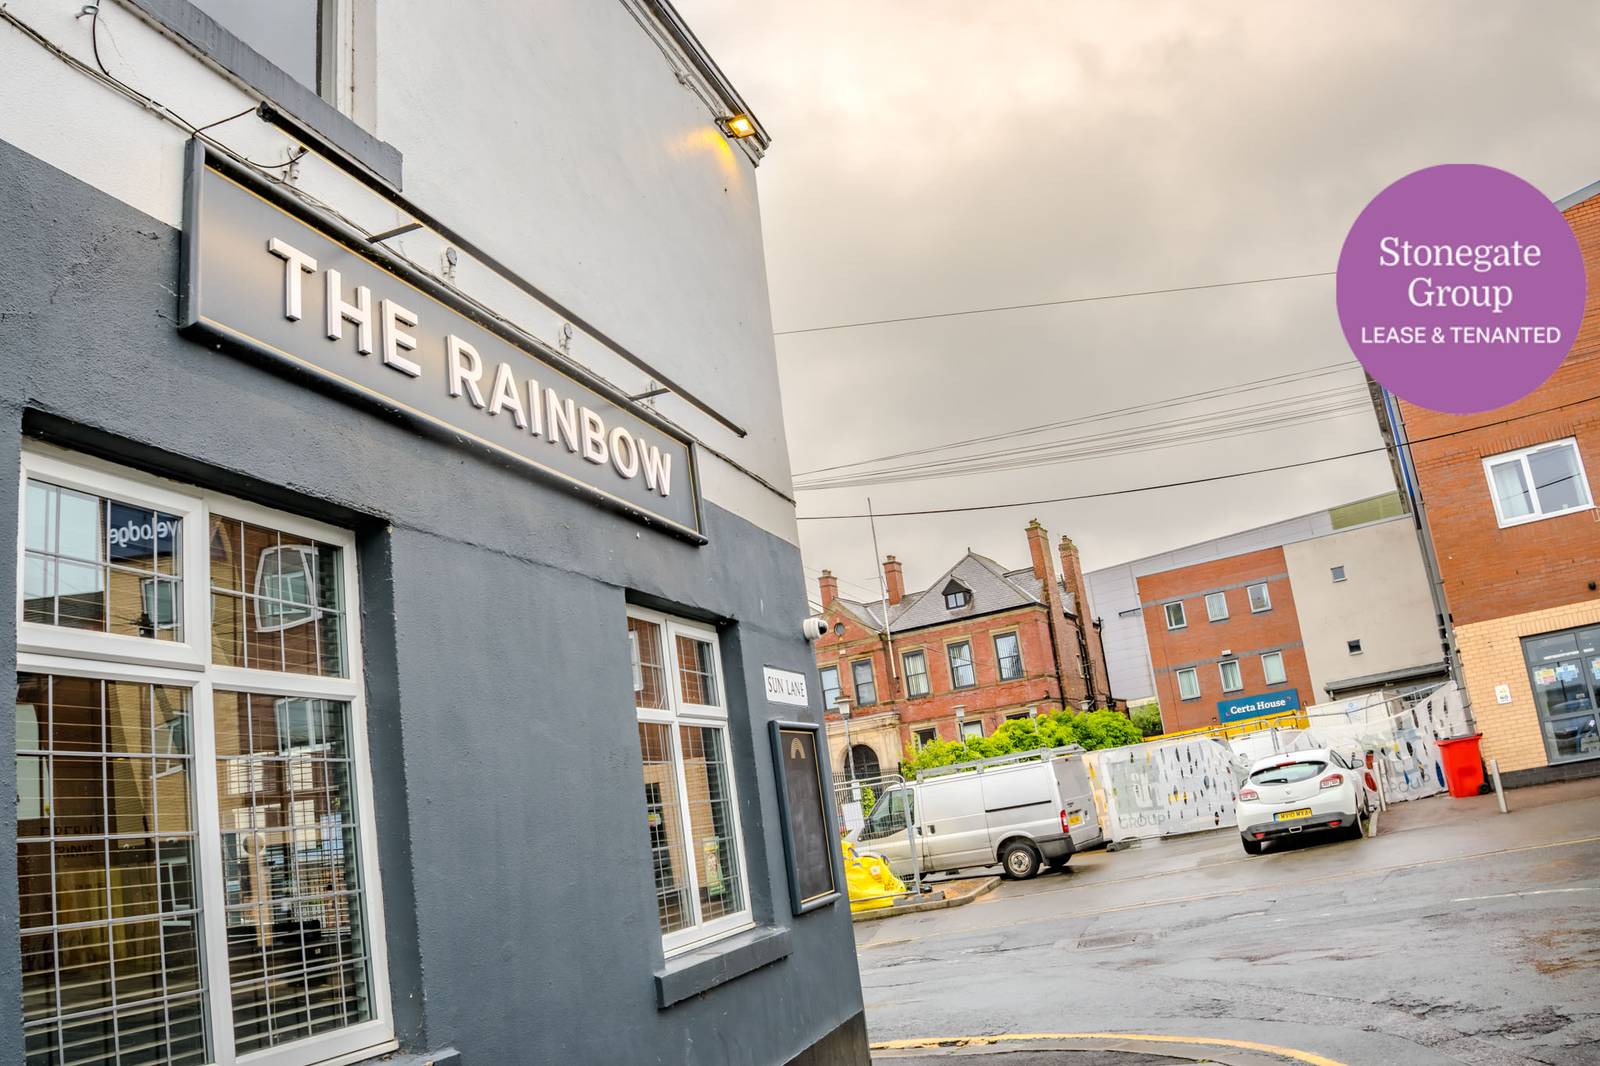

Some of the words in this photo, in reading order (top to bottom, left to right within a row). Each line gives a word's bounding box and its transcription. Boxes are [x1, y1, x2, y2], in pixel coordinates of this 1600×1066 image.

[268, 237, 421, 378] THE
[447, 334, 671, 496] RAINBOW
[768, 676, 783, 693] SUN
[786, 680, 805, 697] LANE
[1230, 704, 1256, 714] Certa
[1257, 699, 1286, 710] House
[54, 844, 95, 858] RIDAYS
